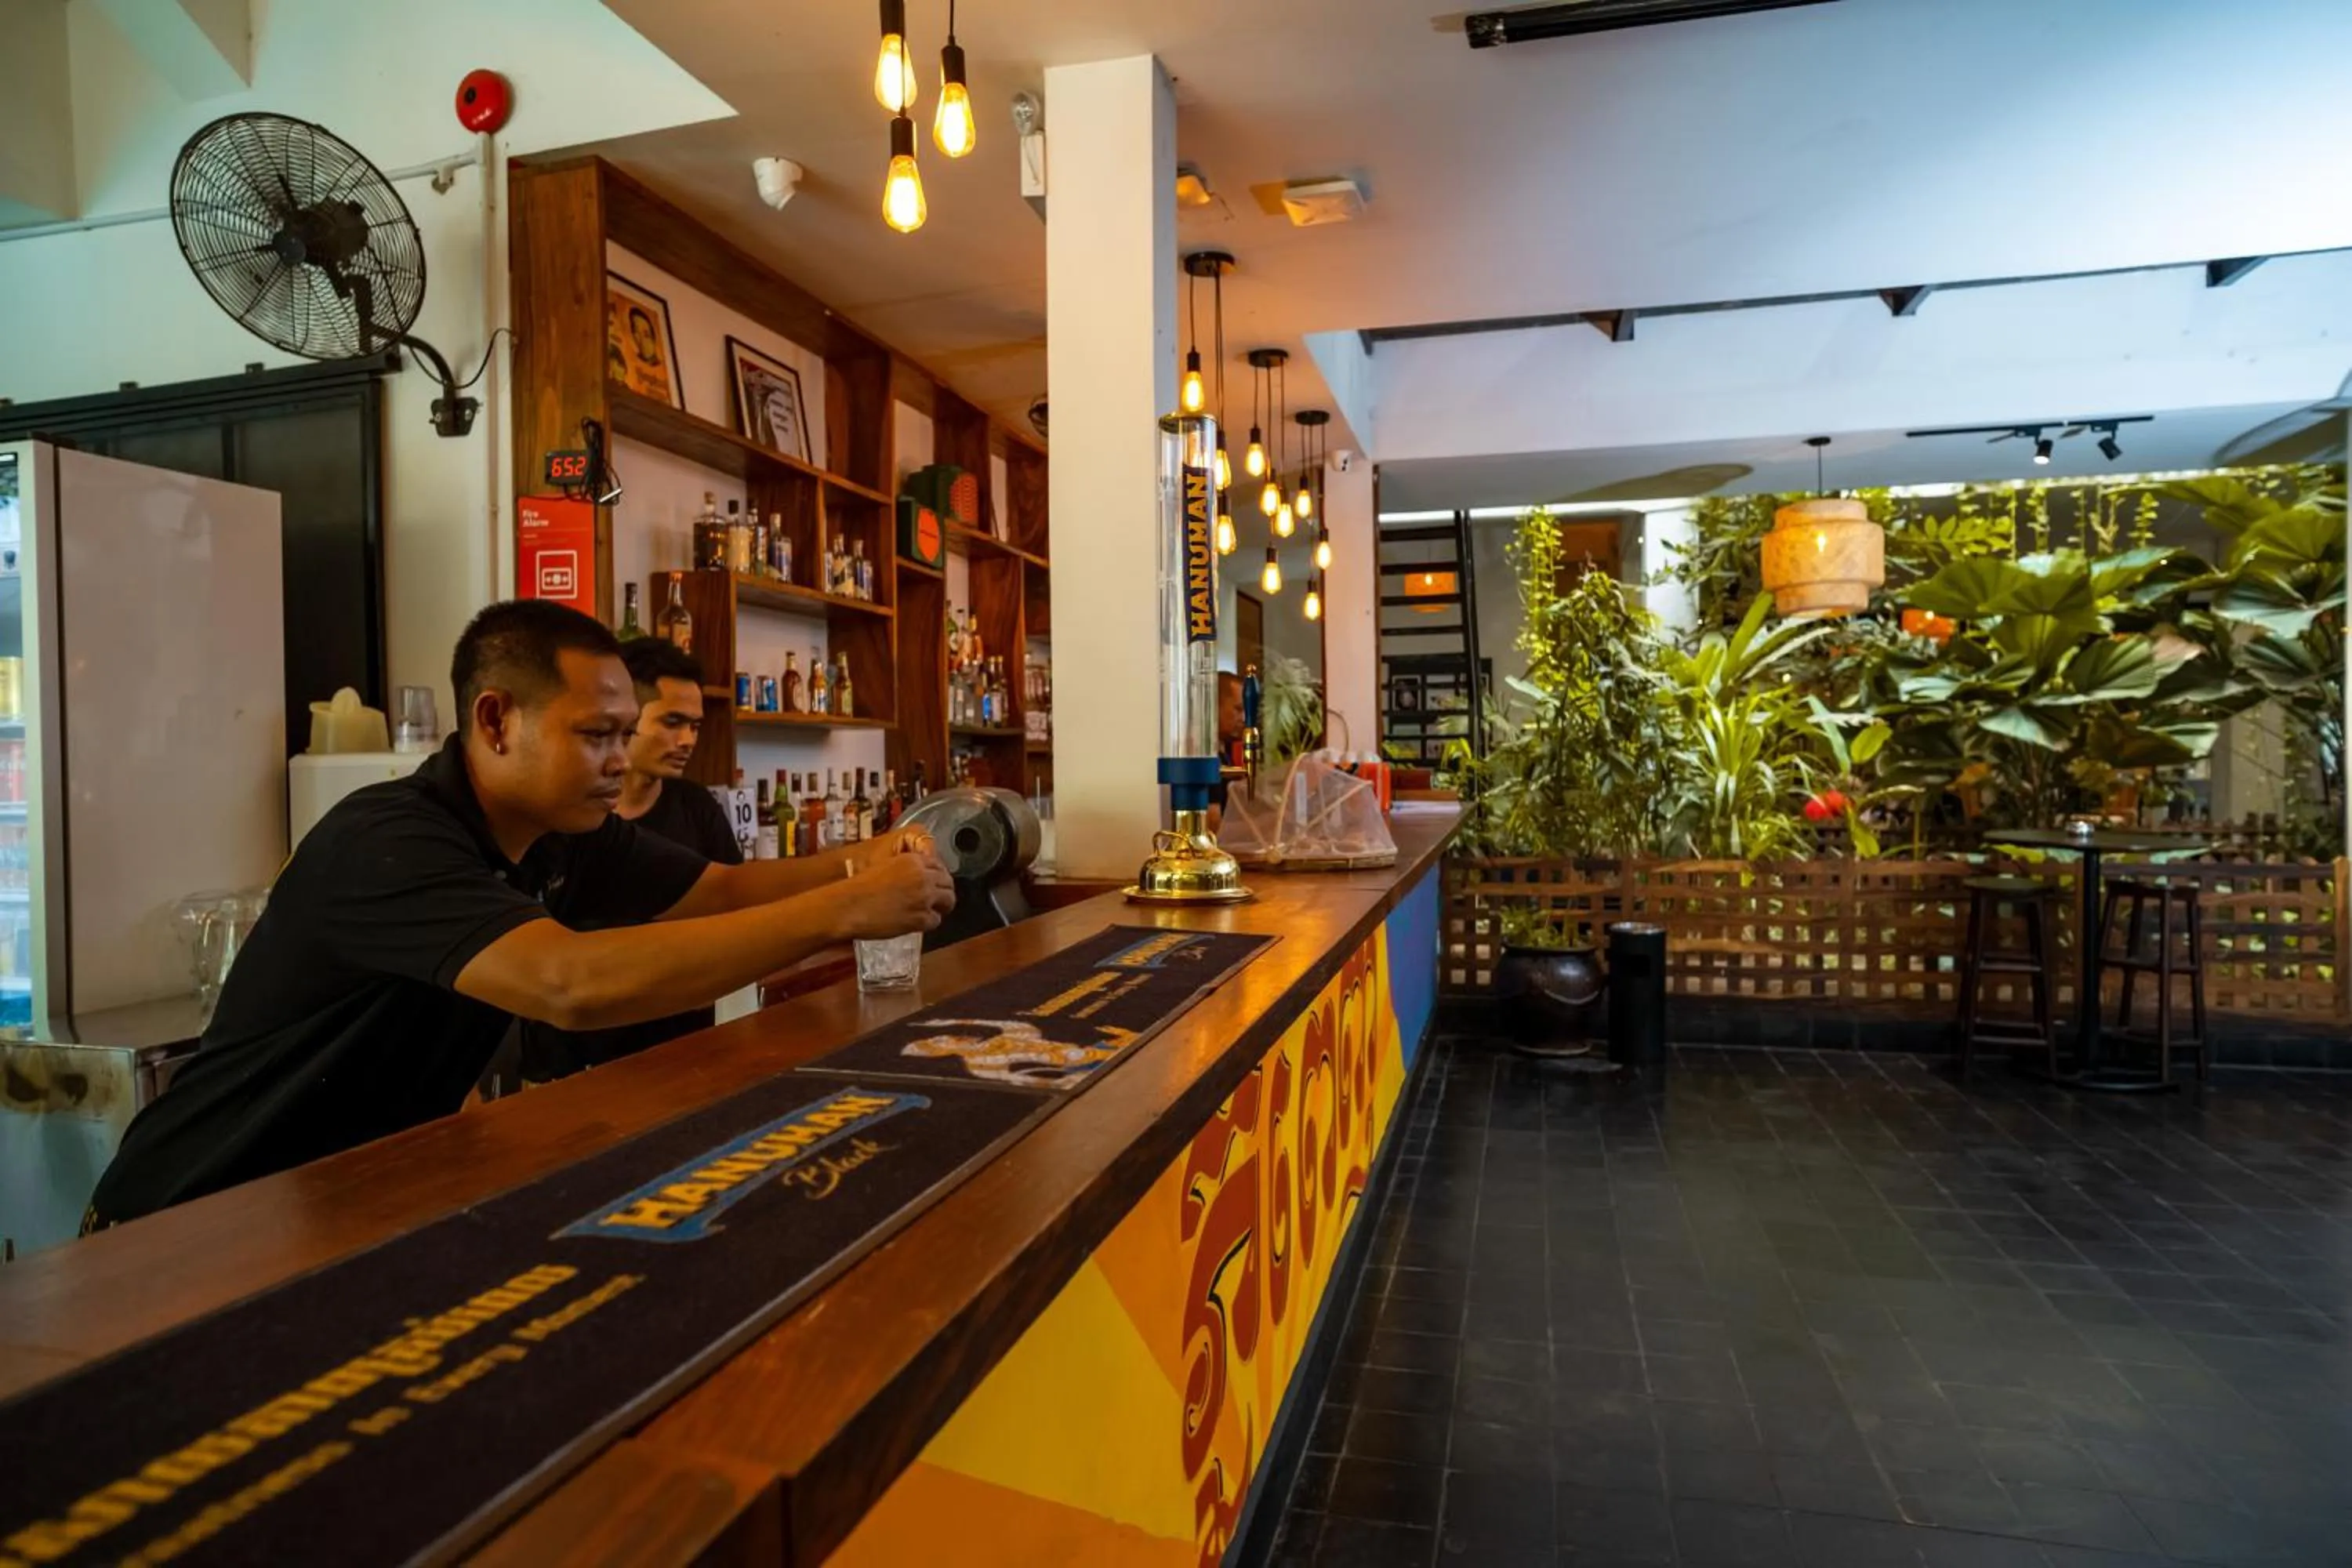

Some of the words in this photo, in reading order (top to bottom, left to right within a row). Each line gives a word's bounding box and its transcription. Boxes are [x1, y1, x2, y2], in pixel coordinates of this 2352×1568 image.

[522, 517, 550, 527] Alarm
[523, 510, 539, 518] Fire
[1186, 473, 1212, 636] HANUMAN
[735, 803, 752, 825] 10
[597, 1093, 898, 1229] HANUMAN
[782, 1138, 901, 1200] Black
